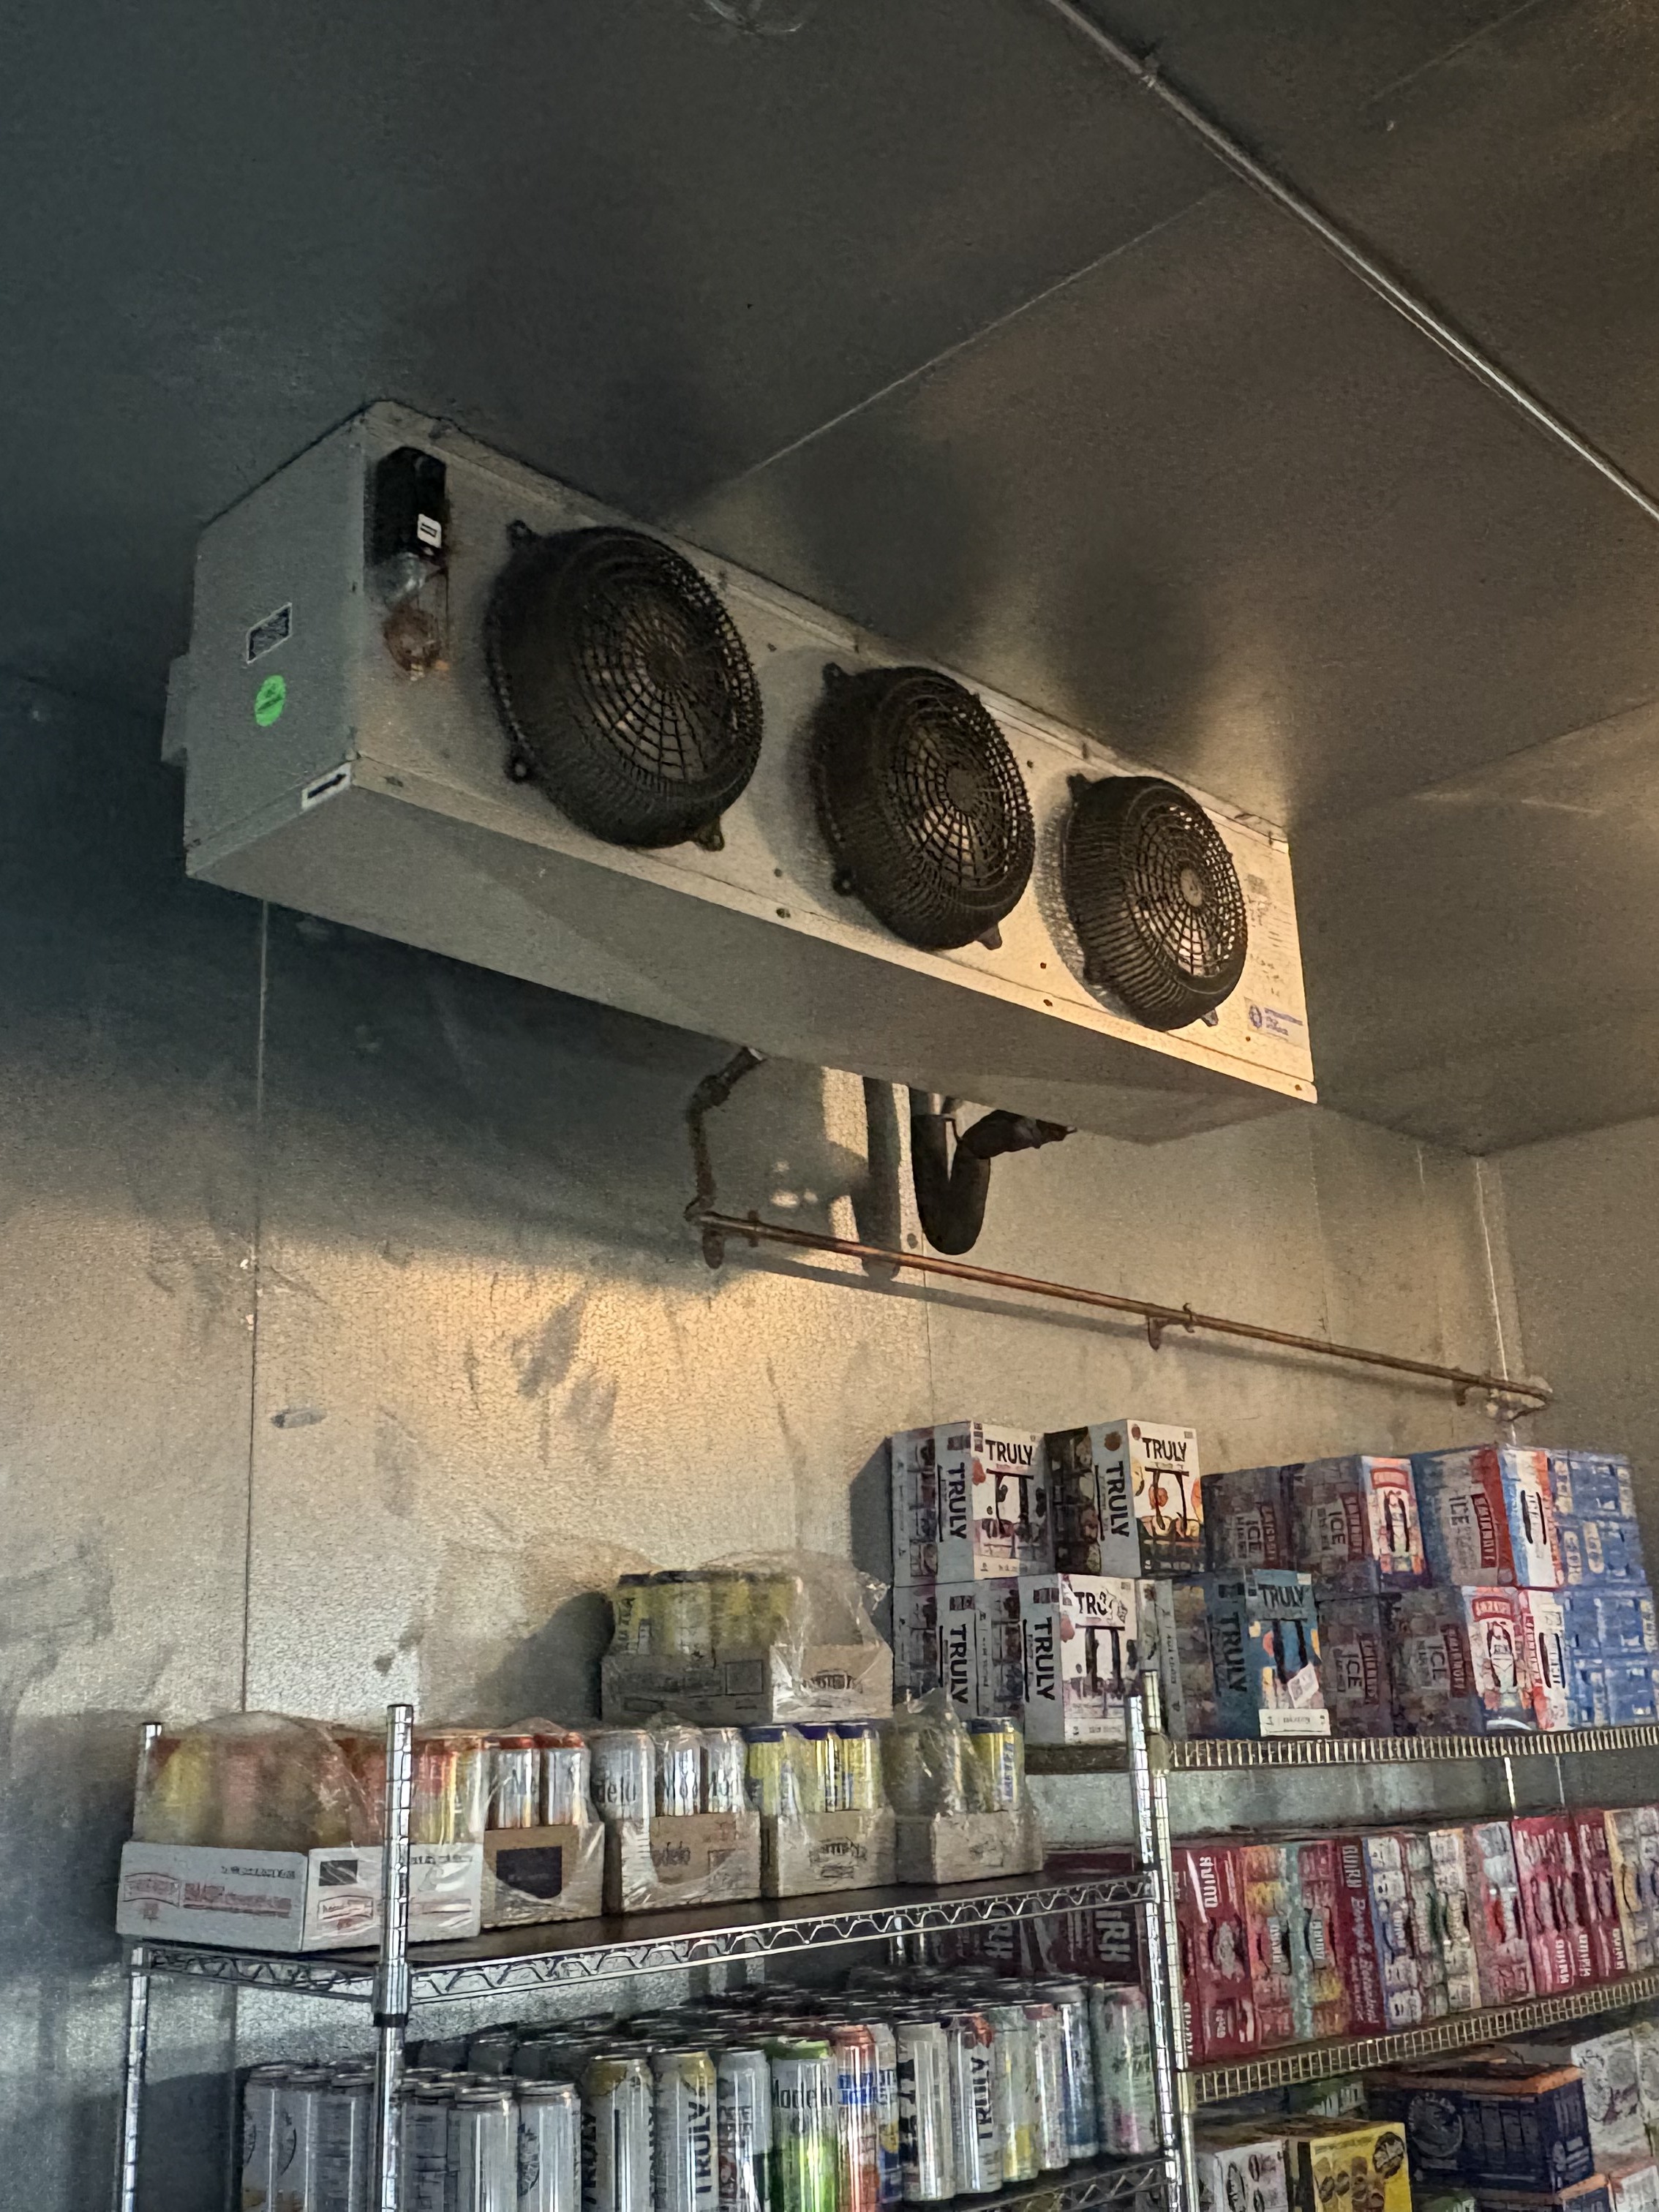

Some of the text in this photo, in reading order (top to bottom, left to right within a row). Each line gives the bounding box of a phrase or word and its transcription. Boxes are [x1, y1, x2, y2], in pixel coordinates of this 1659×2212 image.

[985, 1439, 1033, 1466] TRULY
[1142, 1437, 1186, 1462] TRULY
[948, 1462, 967, 1539] TRULY
[1106, 1461, 1129, 1537] TRULY
[1328, 1511, 1346, 1545] ICE
[1258, 1584, 1305, 1607] TRULY
[950, 1624, 968, 1704] TRULY
[1034, 1617, 1056, 1701] TRULY
[1219, 1611, 1247, 1693] TRULY
[1341, 1654, 1362, 1688] ICE
[1200, 1856, 1218, 1908] QUIRK
[1342, 1844, 1362, 1888] QUIRK
[688, 2101, 712, 2194] TRULY
